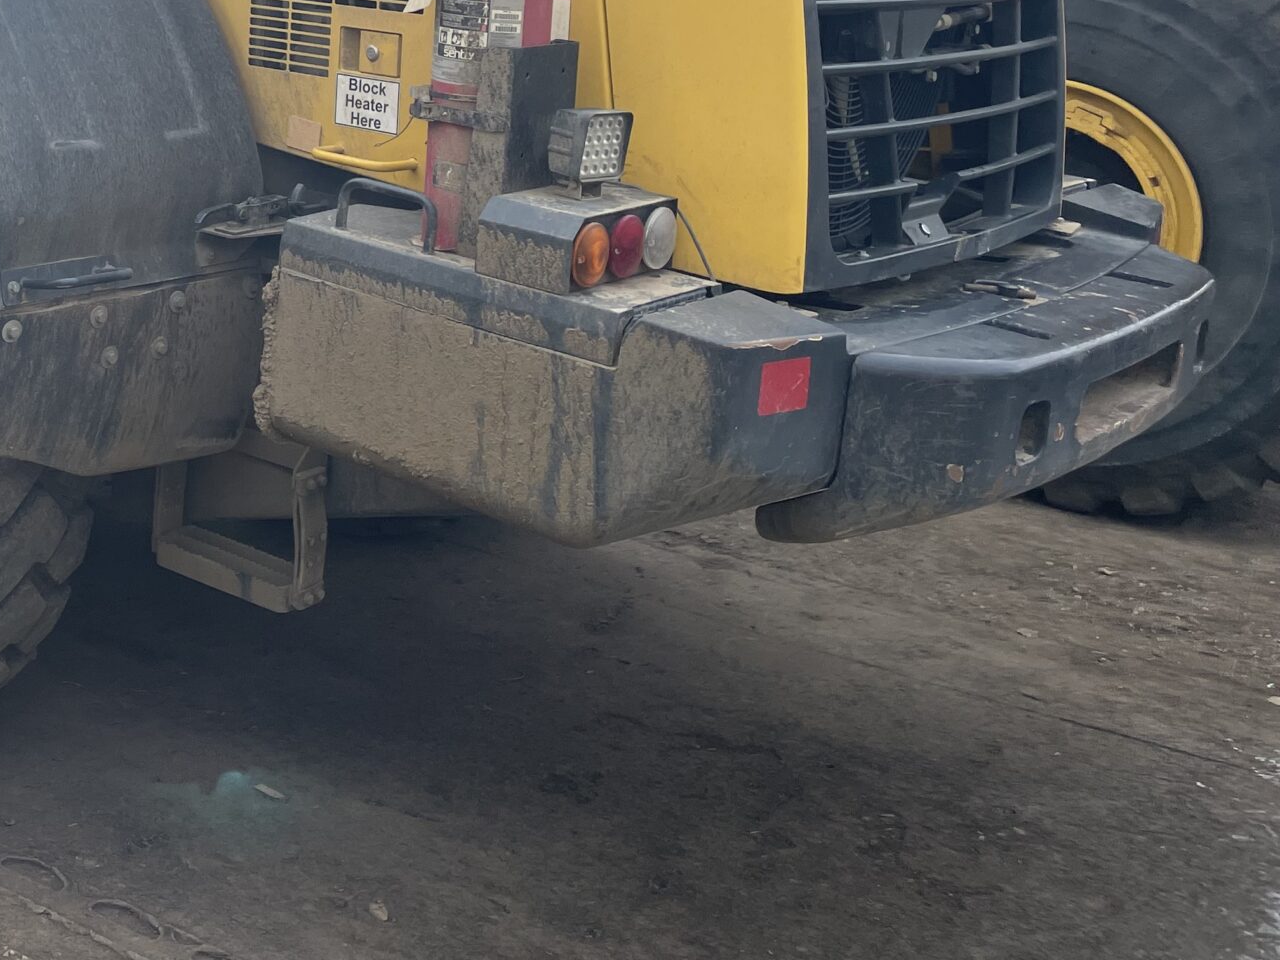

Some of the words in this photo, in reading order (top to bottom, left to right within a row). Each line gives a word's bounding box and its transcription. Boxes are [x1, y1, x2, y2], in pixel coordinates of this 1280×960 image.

[443, 49, 476, 60] senty
[349, 78, 386, 96] Block
[345, 93, 389, 113] Heater
[350, 111, 381, 129] Here
